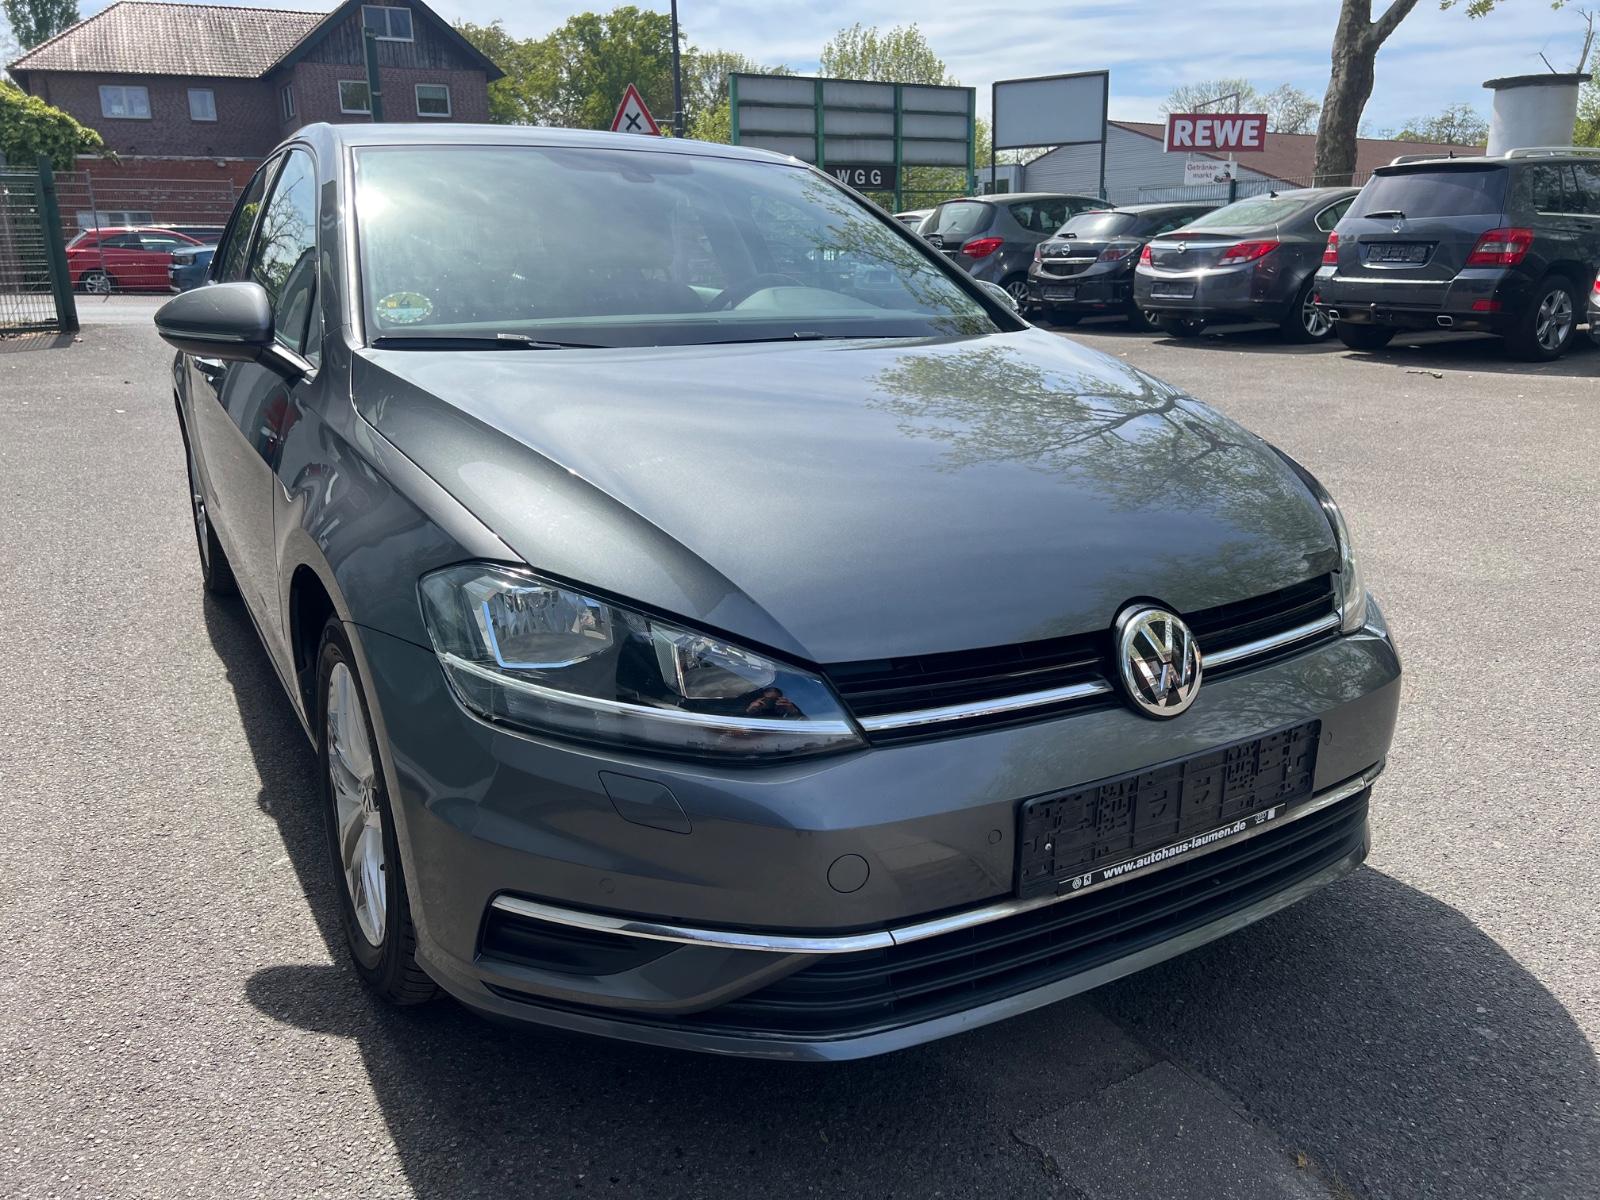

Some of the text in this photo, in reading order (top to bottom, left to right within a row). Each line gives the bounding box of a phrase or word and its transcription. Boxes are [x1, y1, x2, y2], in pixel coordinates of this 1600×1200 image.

[1173, 119, 1259, 148] REWE
[836, 169, 882, 185] WGG
[1104, 821, 1247, 879] www.autohaus-laumen.de
